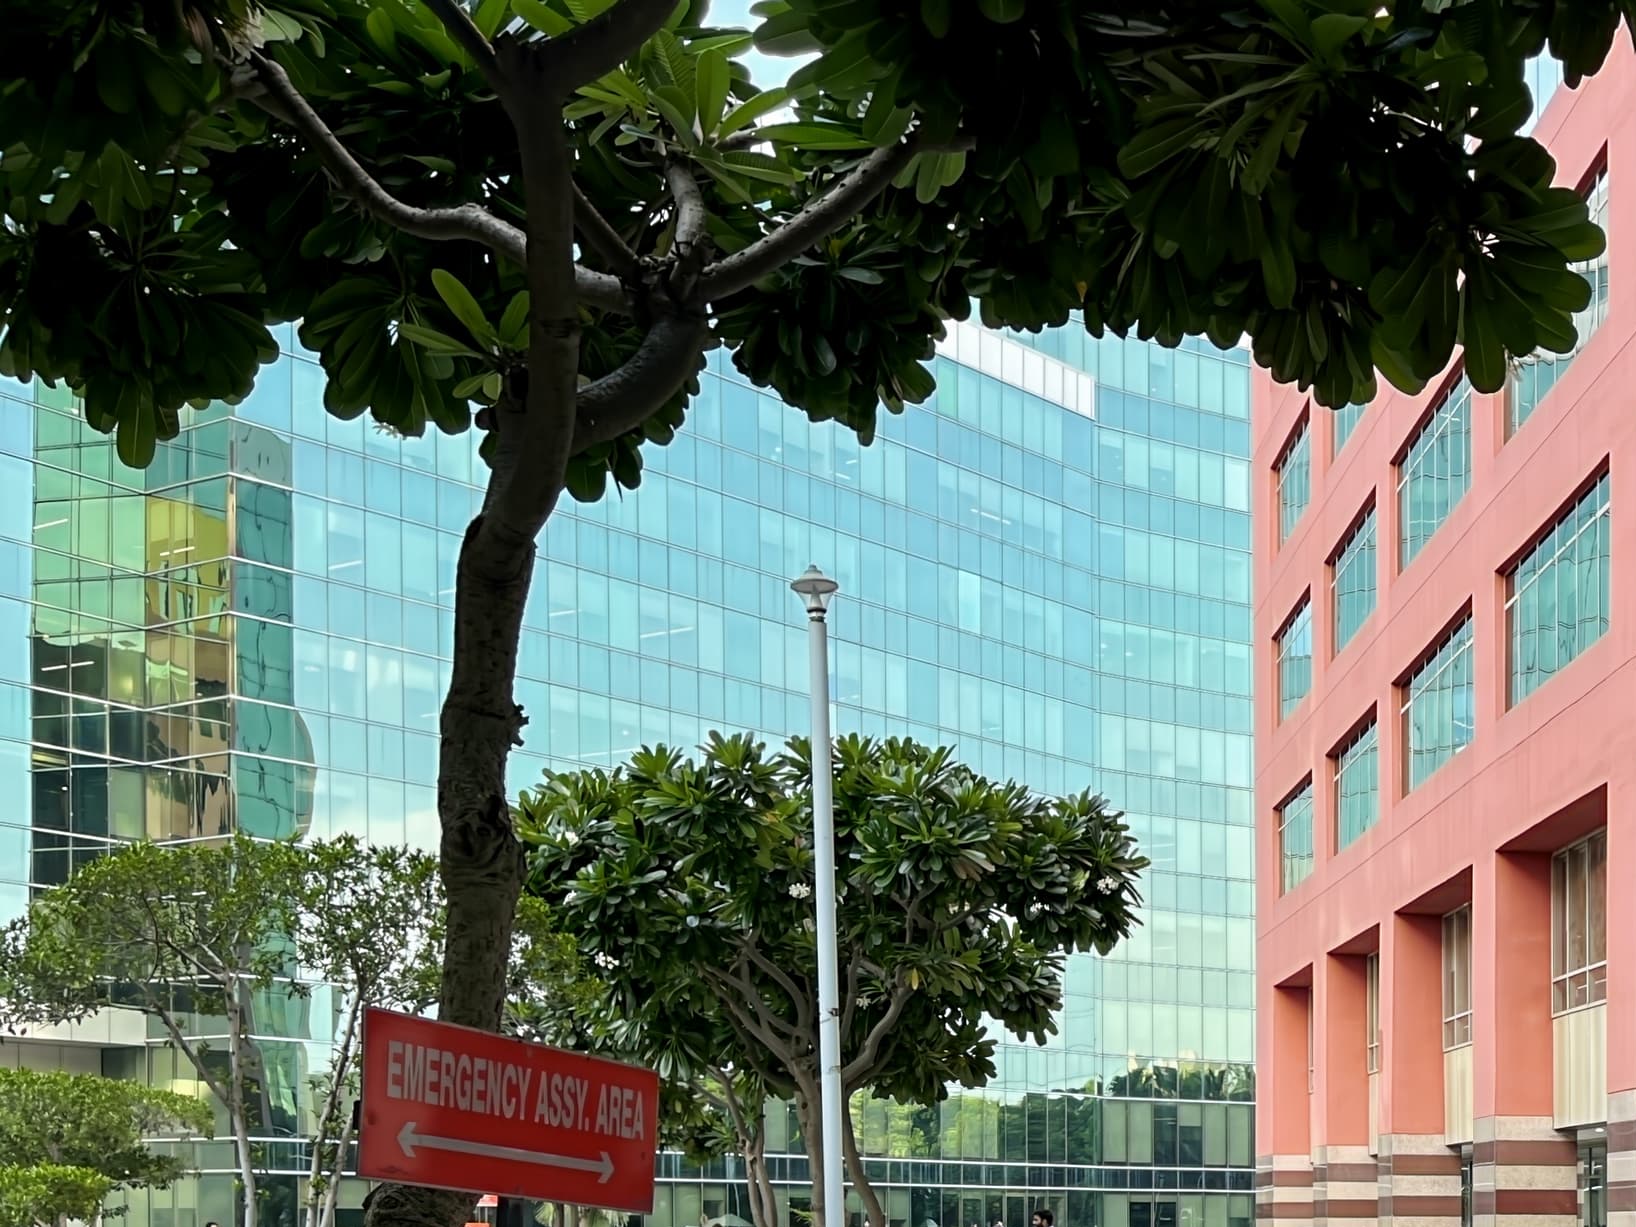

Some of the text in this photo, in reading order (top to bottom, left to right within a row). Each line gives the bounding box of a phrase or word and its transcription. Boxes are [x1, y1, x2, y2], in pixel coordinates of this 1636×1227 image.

[387, 1039, 645, 1141] EMERGENCY ASSY. AREA
